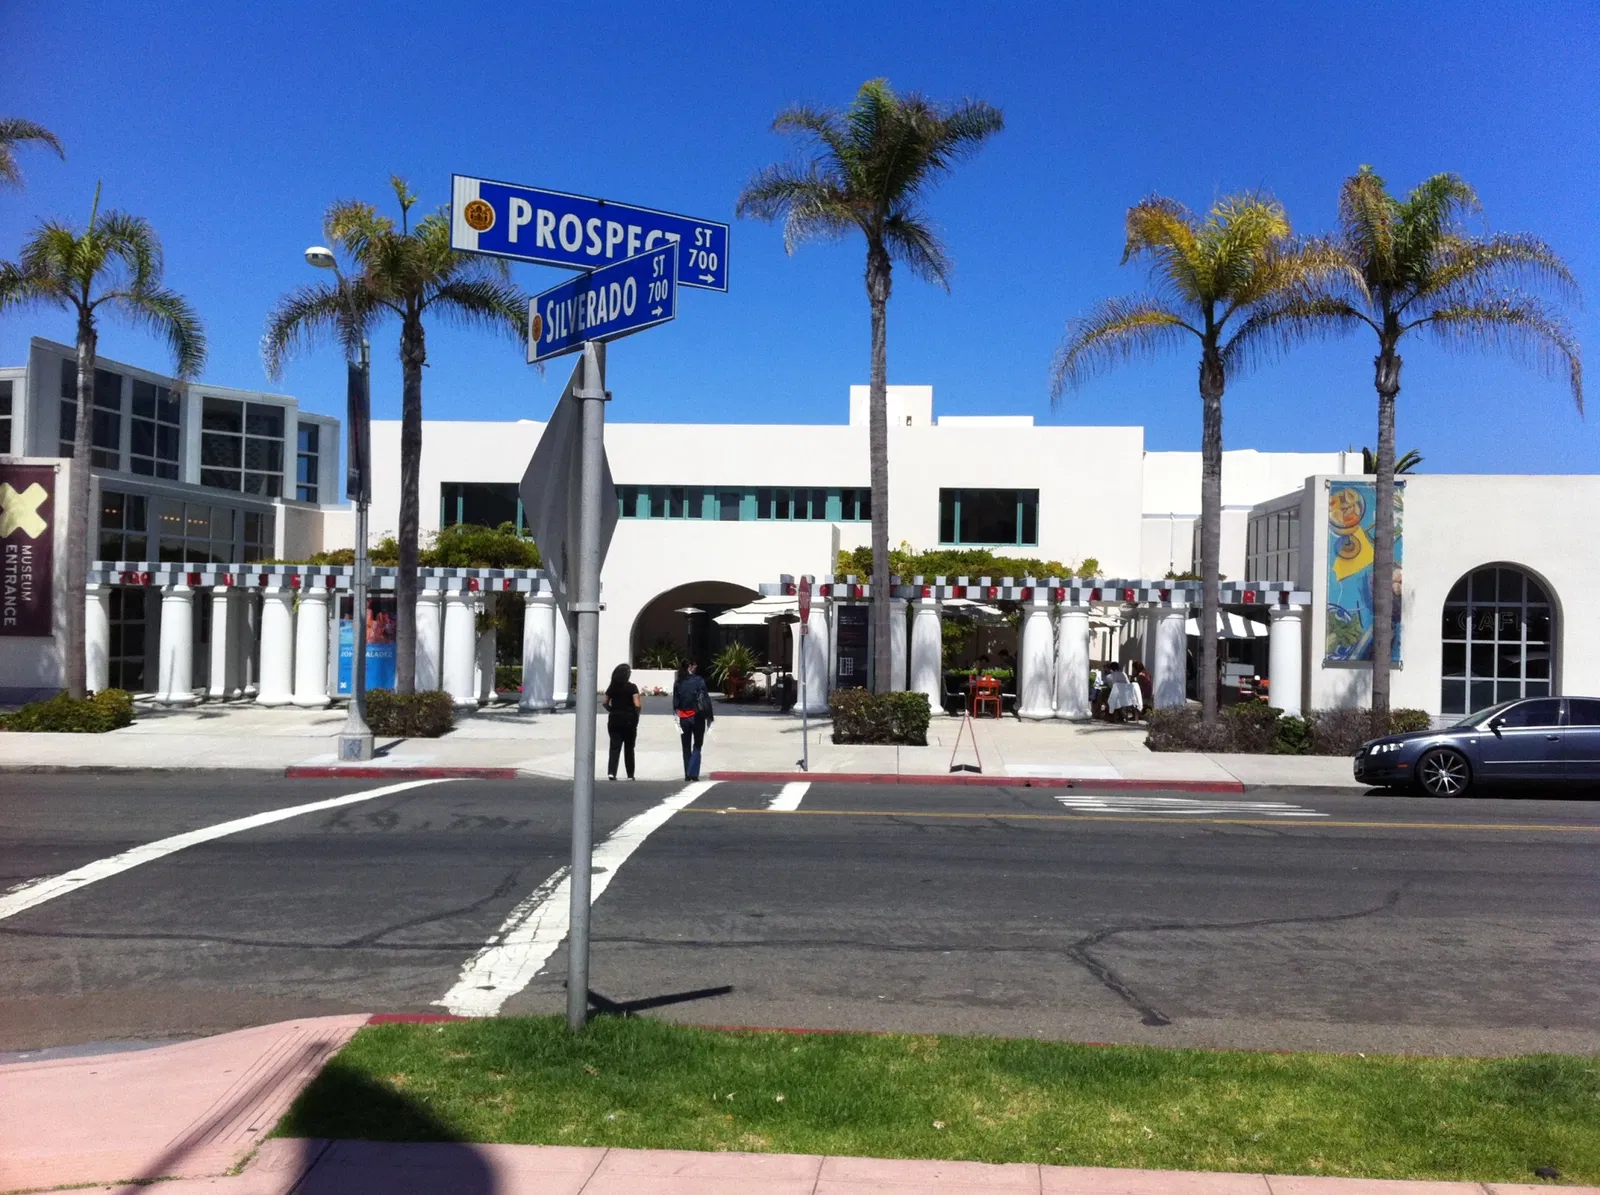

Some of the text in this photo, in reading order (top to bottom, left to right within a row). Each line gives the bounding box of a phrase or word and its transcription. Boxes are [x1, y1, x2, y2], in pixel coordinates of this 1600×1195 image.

[695, 227, 713, 248] ST
[689, 249, 718, 272] 700
[546, 254, 666, 343] SILVERADO ST
[648, 279, 668, 304] 700
[4, 544, 18, 626] ENTRANCE
[21, 545, 32, 601] MUSEUM
